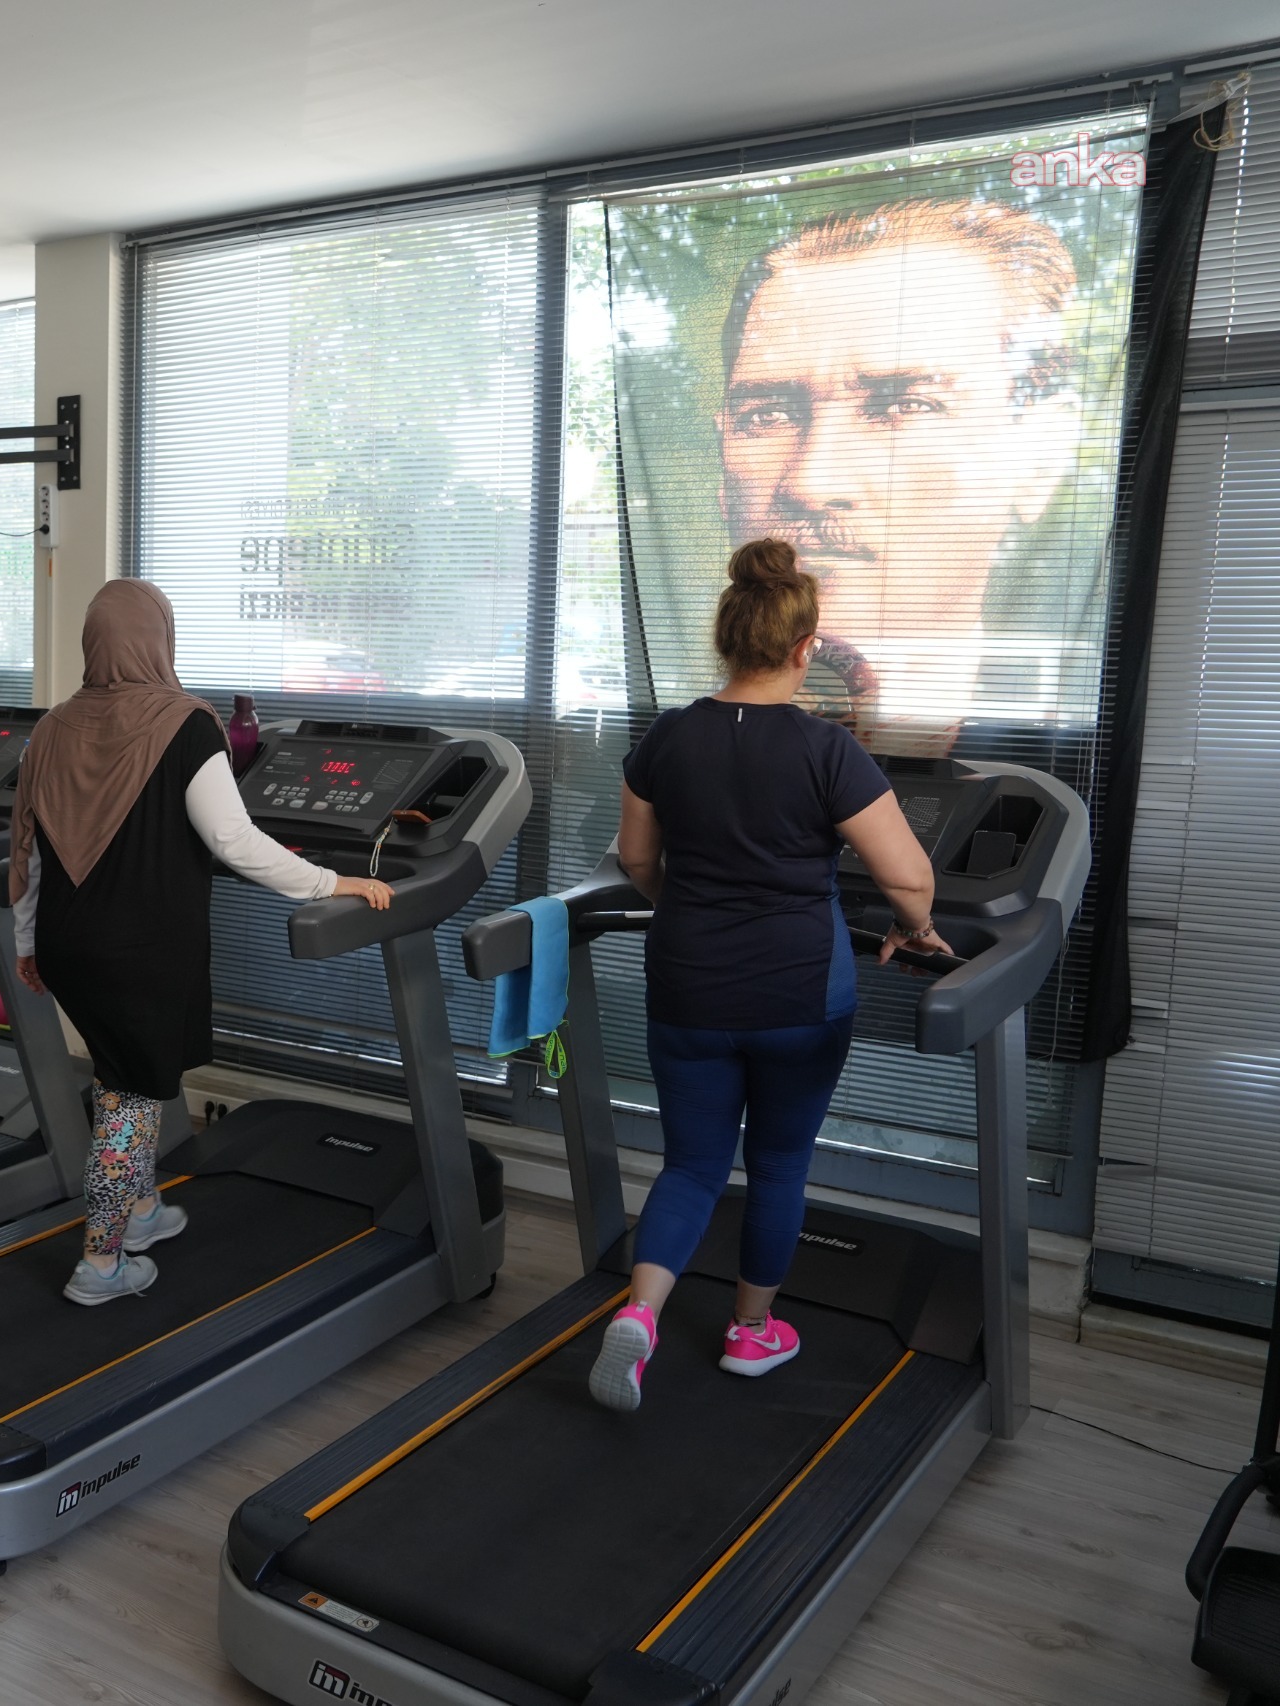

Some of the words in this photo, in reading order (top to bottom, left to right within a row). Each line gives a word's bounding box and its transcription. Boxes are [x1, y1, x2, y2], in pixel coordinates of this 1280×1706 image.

[325, 1136, 374, 1152] impulse
[798, 1230, 858, 1251] mpulse
[81, 1454, 141, 1498] impulse
